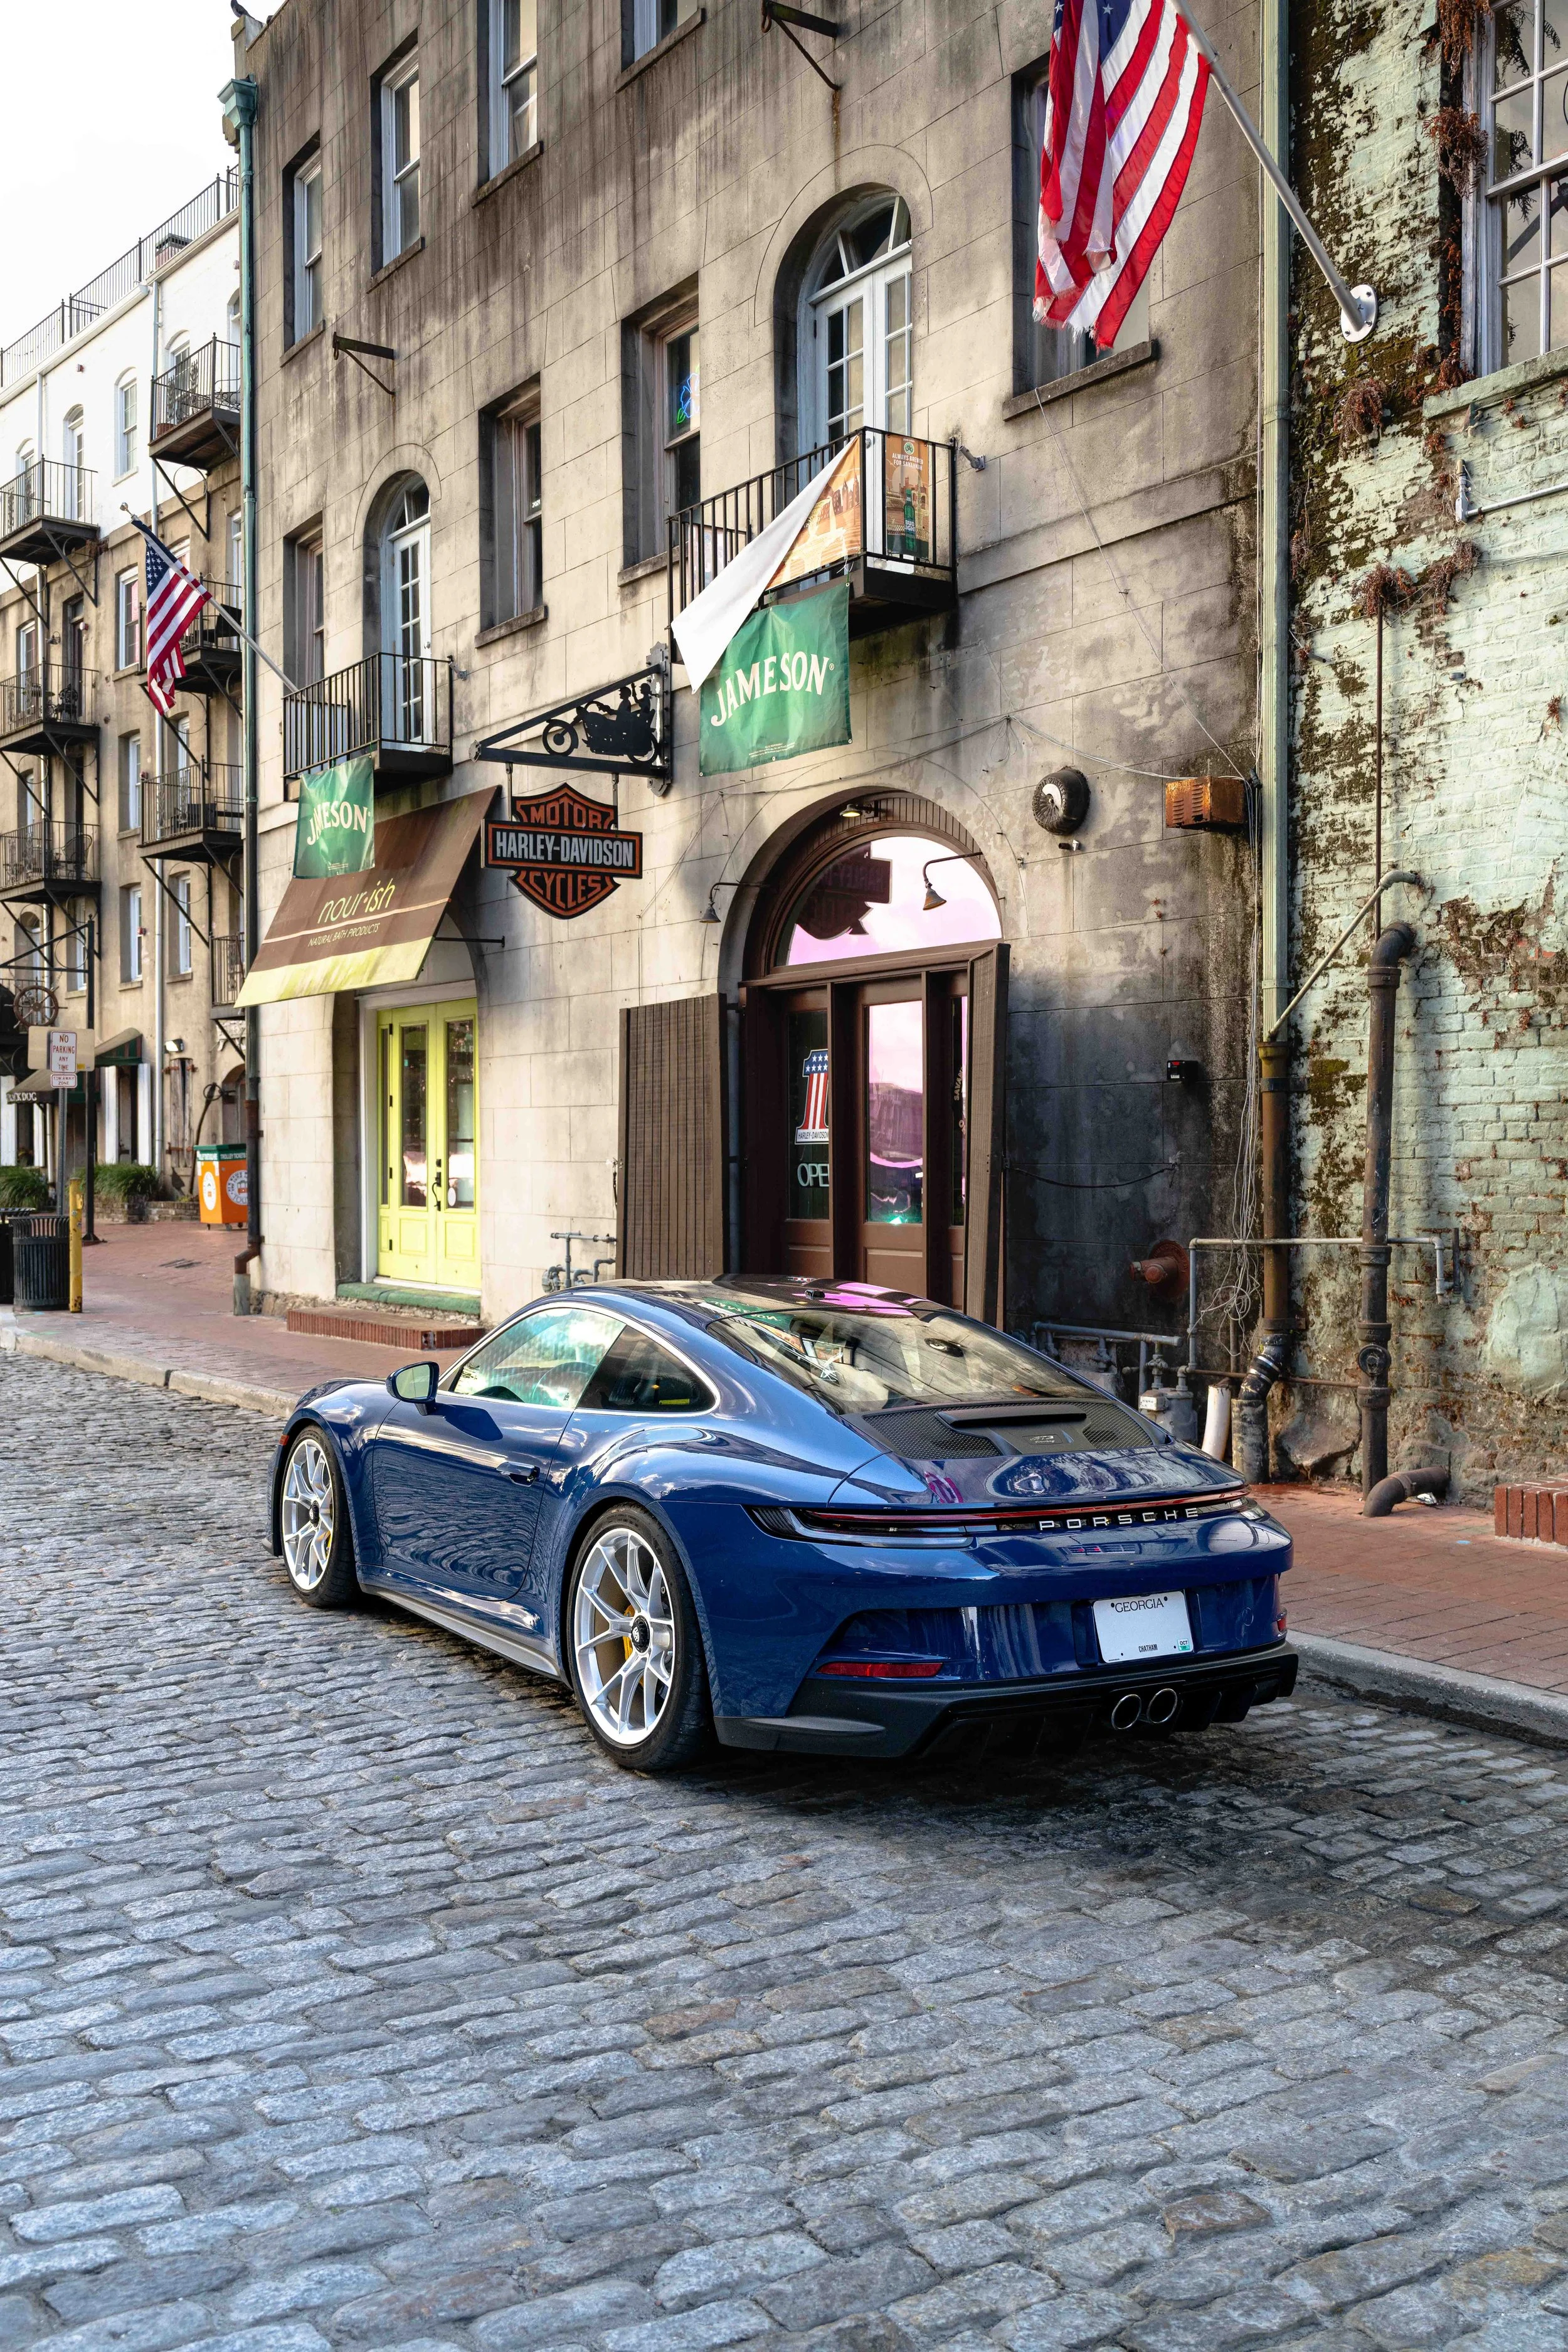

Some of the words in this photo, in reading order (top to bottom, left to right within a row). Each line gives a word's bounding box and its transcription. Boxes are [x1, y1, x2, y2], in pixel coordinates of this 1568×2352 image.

[892, 453, 909, 461] ALWAYS
[530, 795, 602, 829] MOTOR
[496, 831, 633, 867] HARLEY-DAVIDSON
[529, 870, 601, 909] CYCLES
[308, 933, 333, 947] NATURAL
[332, 929, 348, 941] BATH
[347, 923, 381, 938] PRODUCTS
[53, 1046, 75, 1054] PARKING
[60, 1035, 69, 1043] NO
[797, 1163, 829, 1187] OPE
[1039, 1507, 1199, 1530] PORSCHE
[1115, 1598, 1164, 1613] GEORGIA
[1138, 1644, 1158, 1653] CHATHAM
